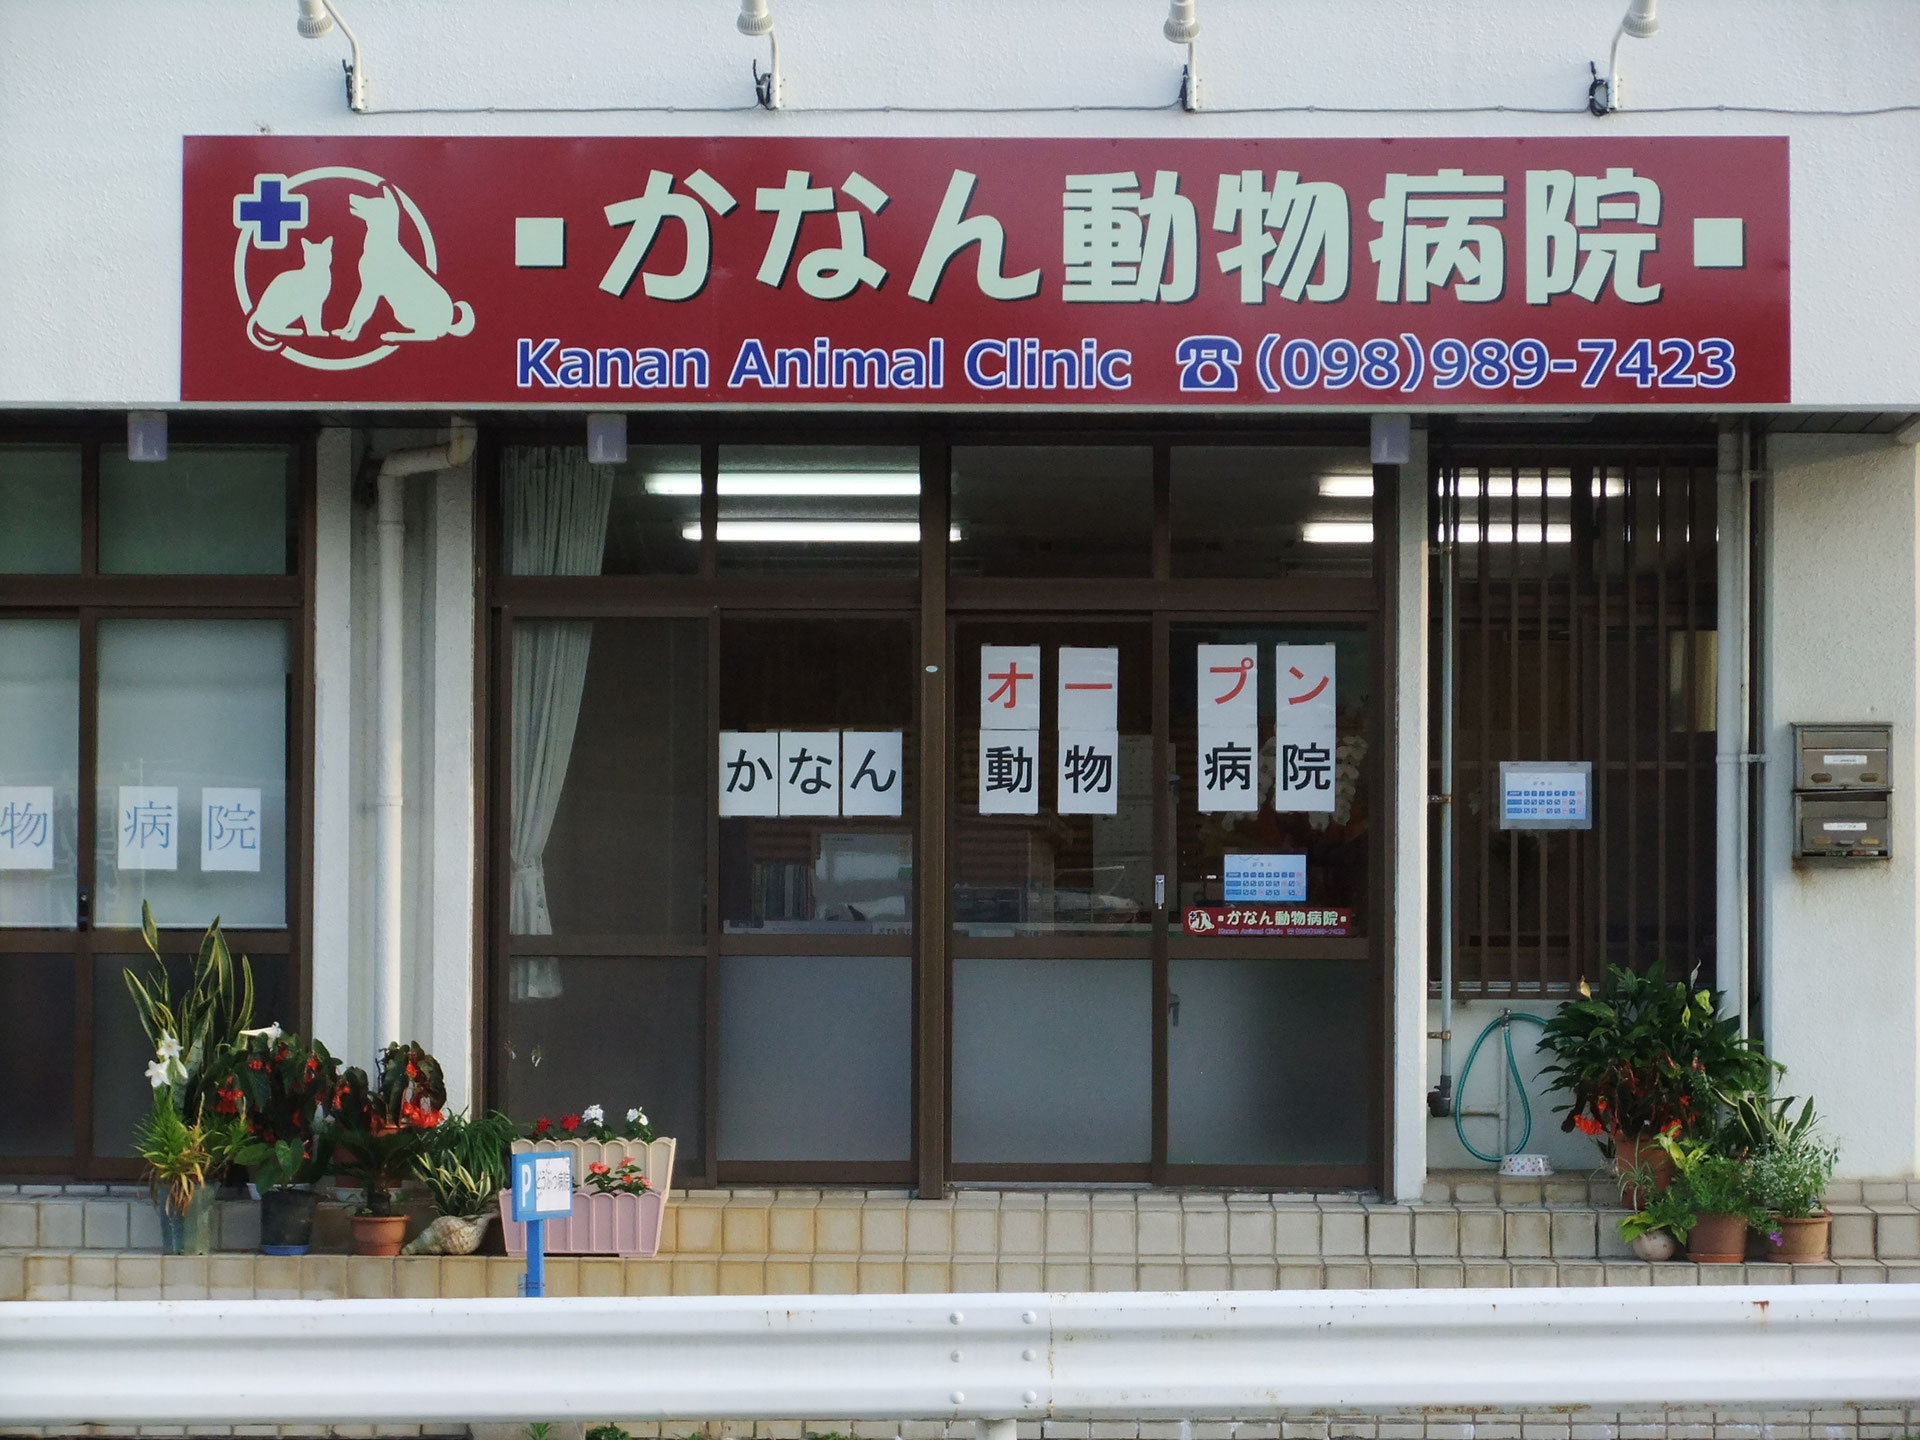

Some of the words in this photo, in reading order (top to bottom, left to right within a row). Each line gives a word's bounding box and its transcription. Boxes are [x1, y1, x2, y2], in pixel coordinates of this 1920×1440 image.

[599, 168, 1662, 304] かなん動物病院
[516, 337, 711, 391] Kanan
[726, 336, 946, 391] Animal
[963, 337, 1134, 391] Clinic
[1256, 333, 1738, 393] (098)989-7423
[727, 747, 897, 795] かなん
[1226, 910, 1339, 926] かなん動物病院
[521, 1164, 532, 1208] P
